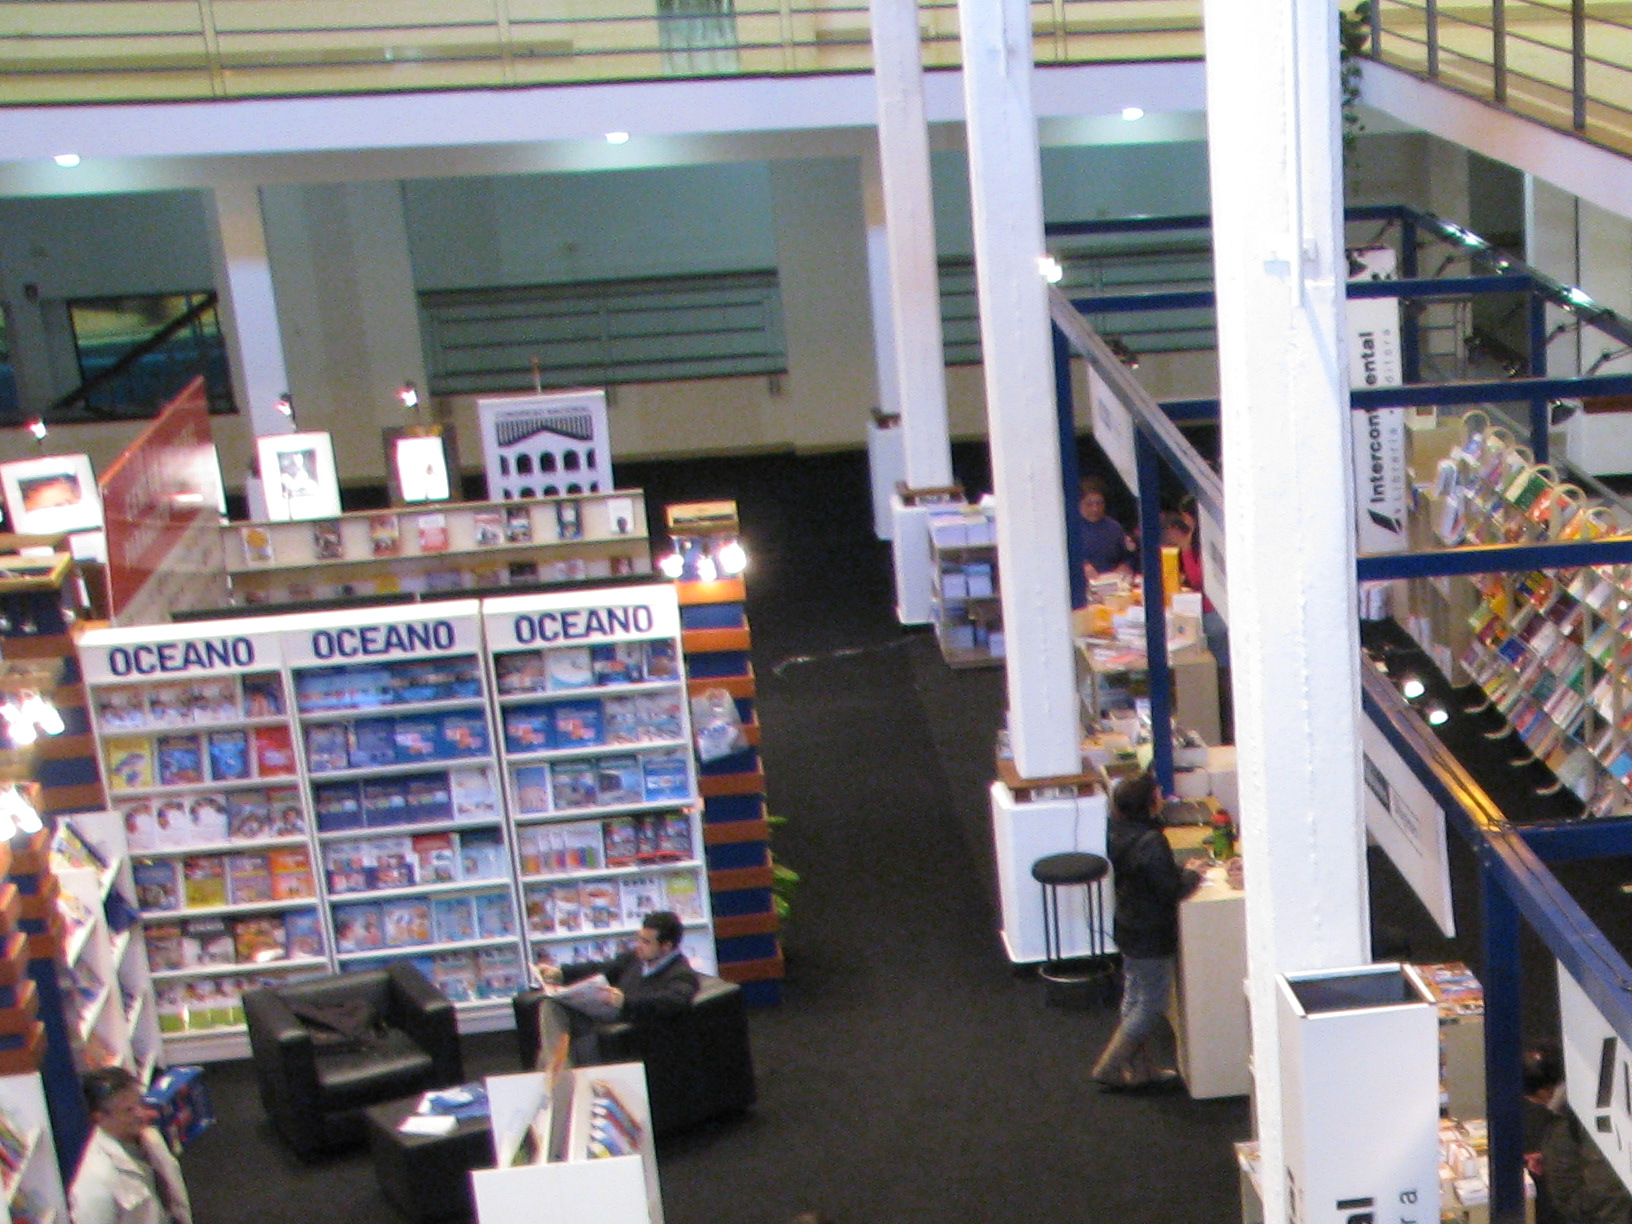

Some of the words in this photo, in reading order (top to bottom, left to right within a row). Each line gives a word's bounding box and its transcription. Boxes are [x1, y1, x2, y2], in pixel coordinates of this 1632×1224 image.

[313, 621, 454, 660] OCEANO
[516, 605, 653, 644] OCEANO
[109, 637, 254, 676] OCEANO
